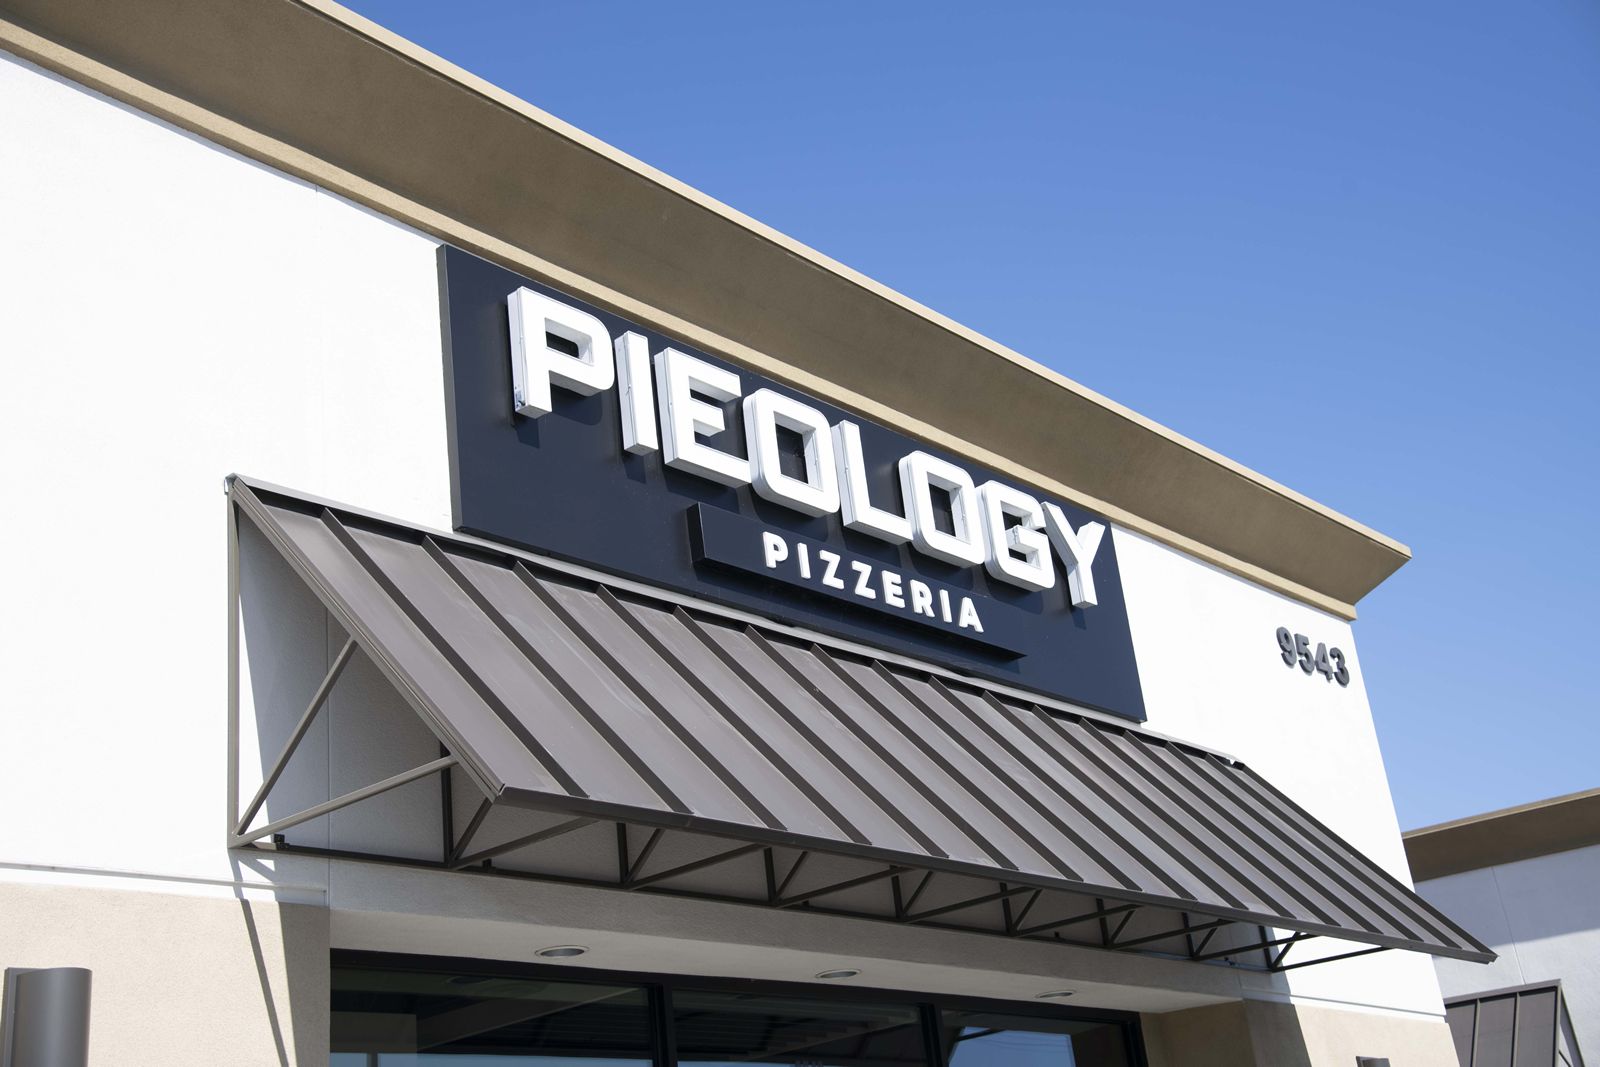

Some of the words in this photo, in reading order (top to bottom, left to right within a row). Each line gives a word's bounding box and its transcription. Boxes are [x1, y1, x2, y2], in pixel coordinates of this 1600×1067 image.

[507, 286, 1109, 609] PIEOLOGY
[762, 531, 984, 633] PIZZERIA
[1276, 626, 1350, 687] 9543
